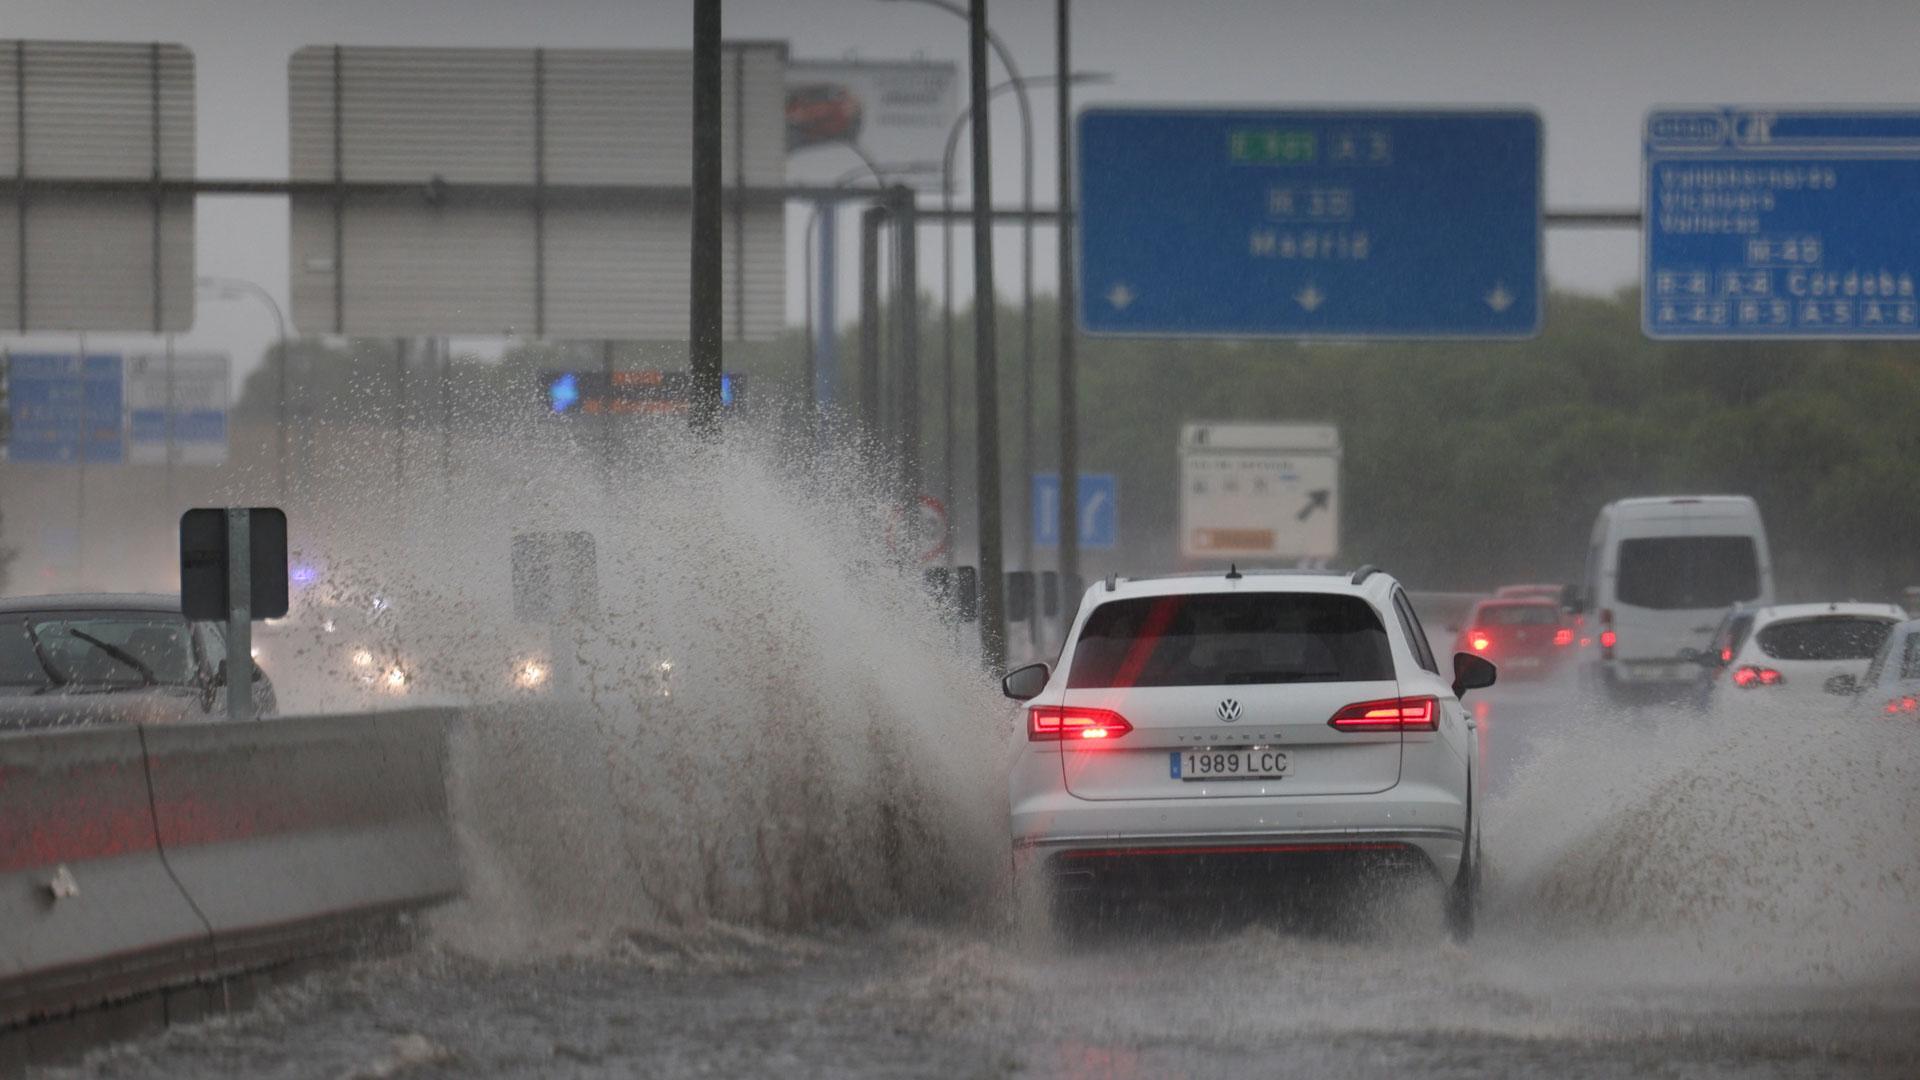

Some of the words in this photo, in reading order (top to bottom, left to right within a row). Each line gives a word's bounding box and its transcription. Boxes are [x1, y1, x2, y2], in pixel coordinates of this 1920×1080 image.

[1249, 227, 1371, 259] Madrid
[1788, 267, 1915, 296] Córdoba
[1802, 300, 1849, 324] A-5
[1188, 753, 1239, 774] 1989
[1247, 753, 1287, 773] LCC
